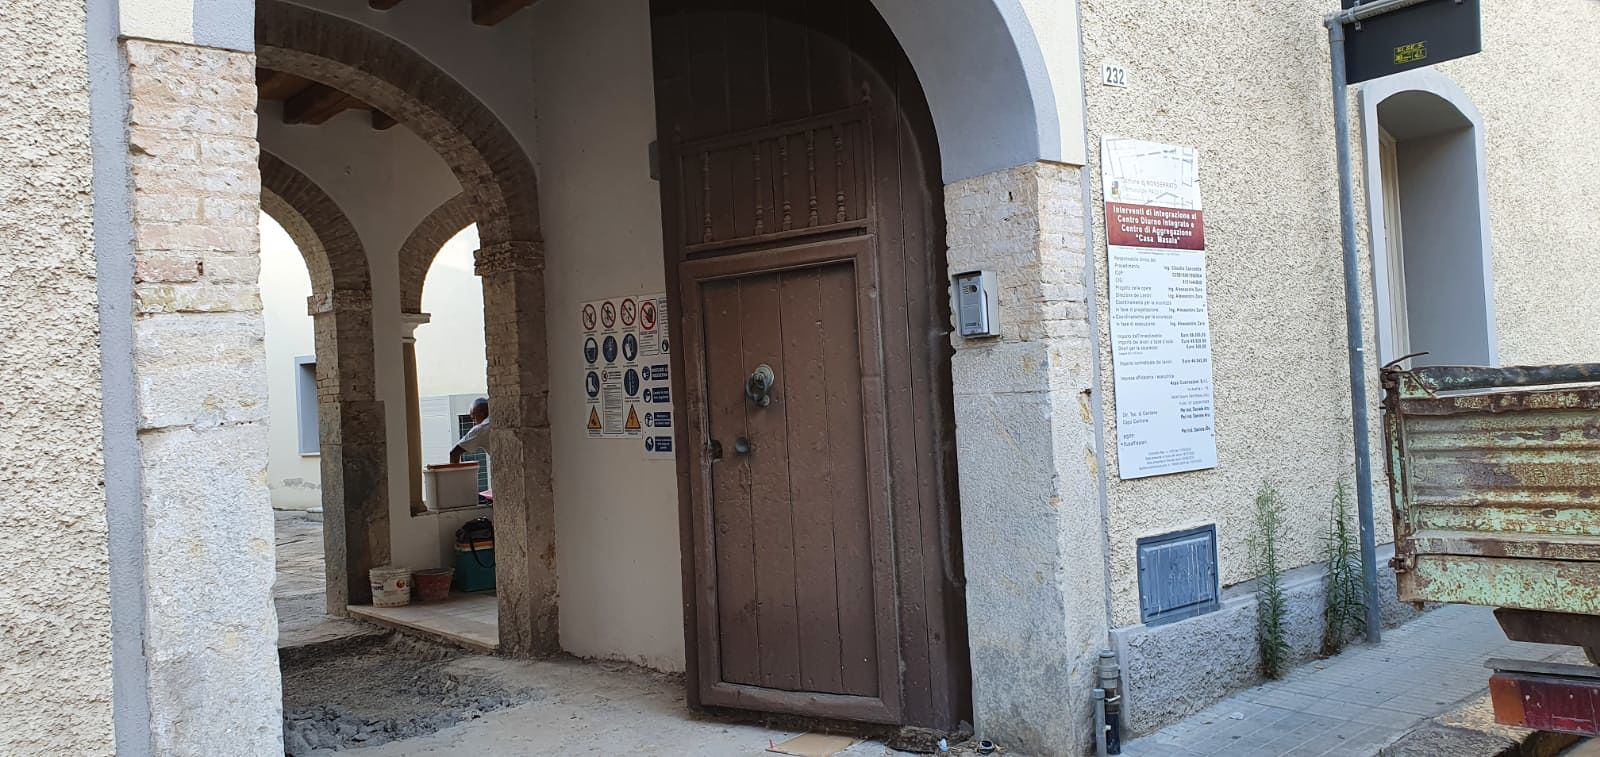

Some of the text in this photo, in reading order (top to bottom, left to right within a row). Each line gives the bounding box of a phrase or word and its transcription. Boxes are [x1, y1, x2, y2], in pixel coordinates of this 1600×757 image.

[1106, 66, 1125, 85] 232
[1113, 205, 1144, 216] Interventi
[1146, 207, 1152, 216] di
[1118, 214, 1139, 224] Centro
[1140, 216, 1162, 226] Diurno
[1162, 218, 1189, 228] Integrato
[1121, 224, 1192, 237] Centro di Aggregazione
